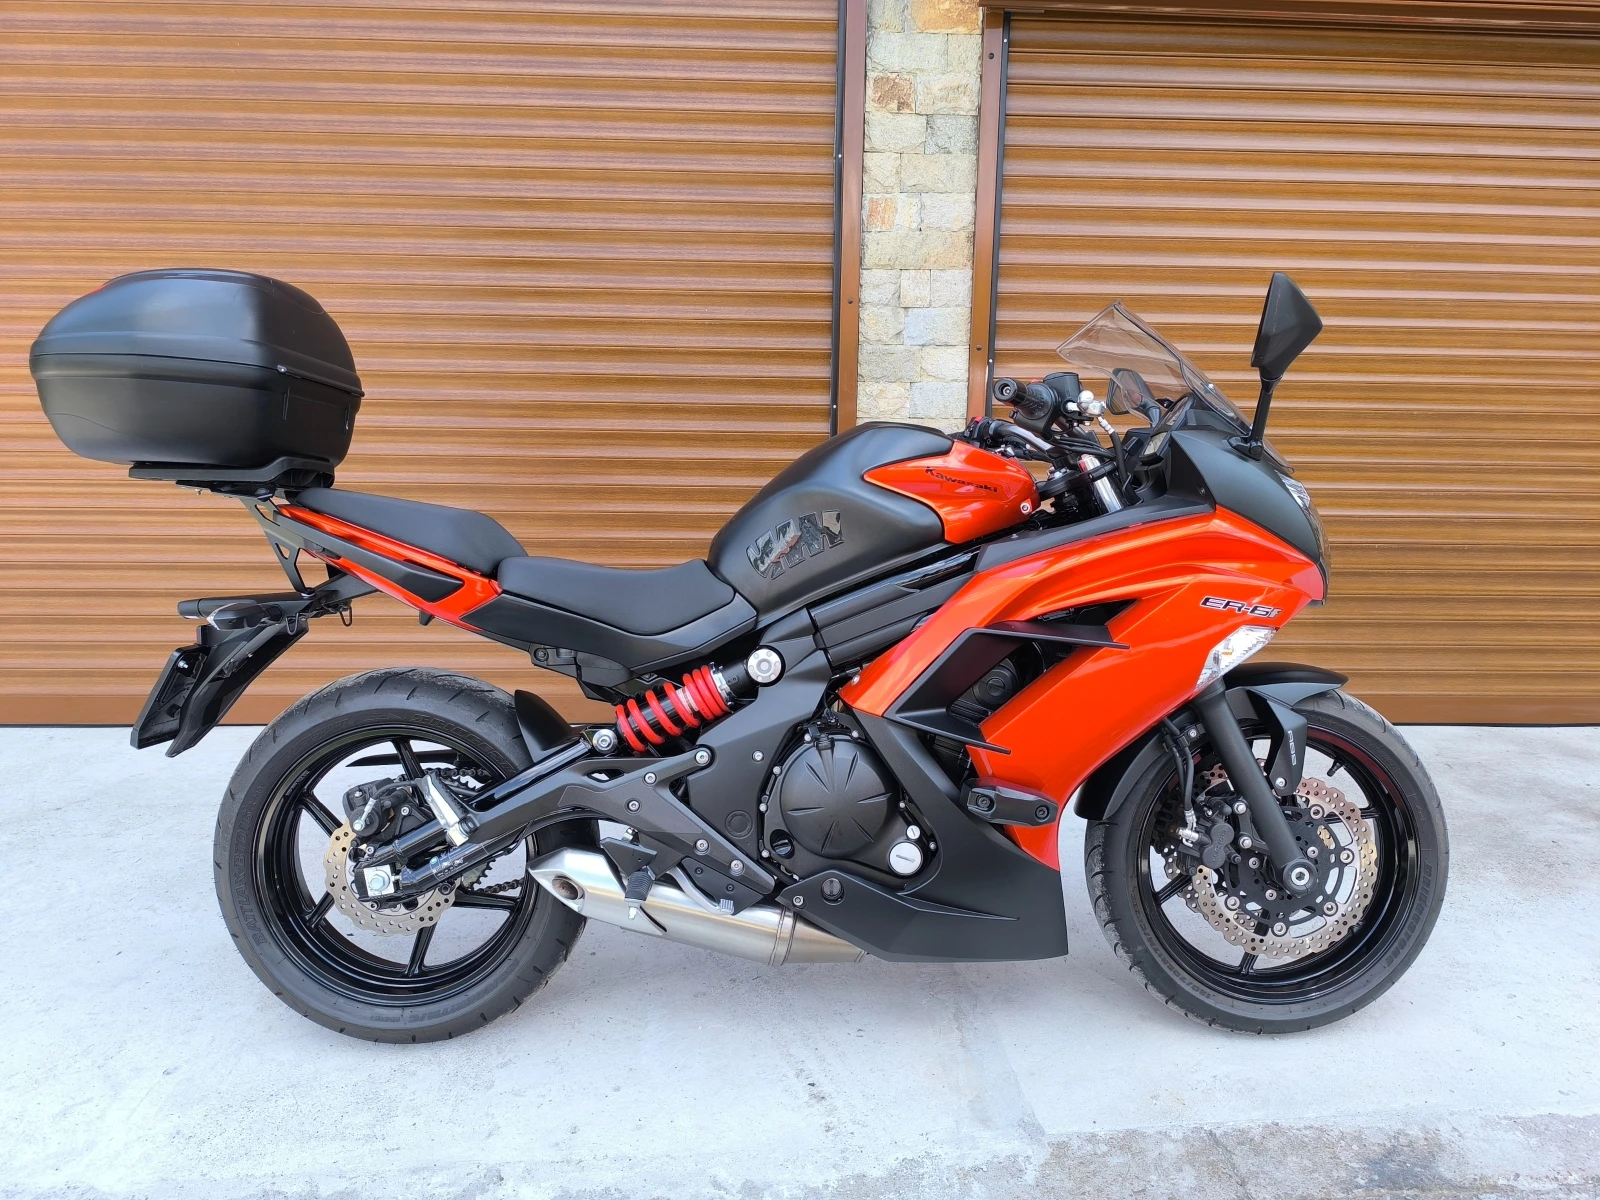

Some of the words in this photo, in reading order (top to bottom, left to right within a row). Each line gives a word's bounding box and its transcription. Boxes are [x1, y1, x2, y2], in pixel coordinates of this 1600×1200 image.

[924, 466, 998, 493] Kawasaki
[1200, 595, 1283, 618] ER-6f
[1287, 729, 1297, 766] ABS
[235, 872, 267, 946] BATTLAX
[1384, 861, 1433, 967] BRIDGESTONE
